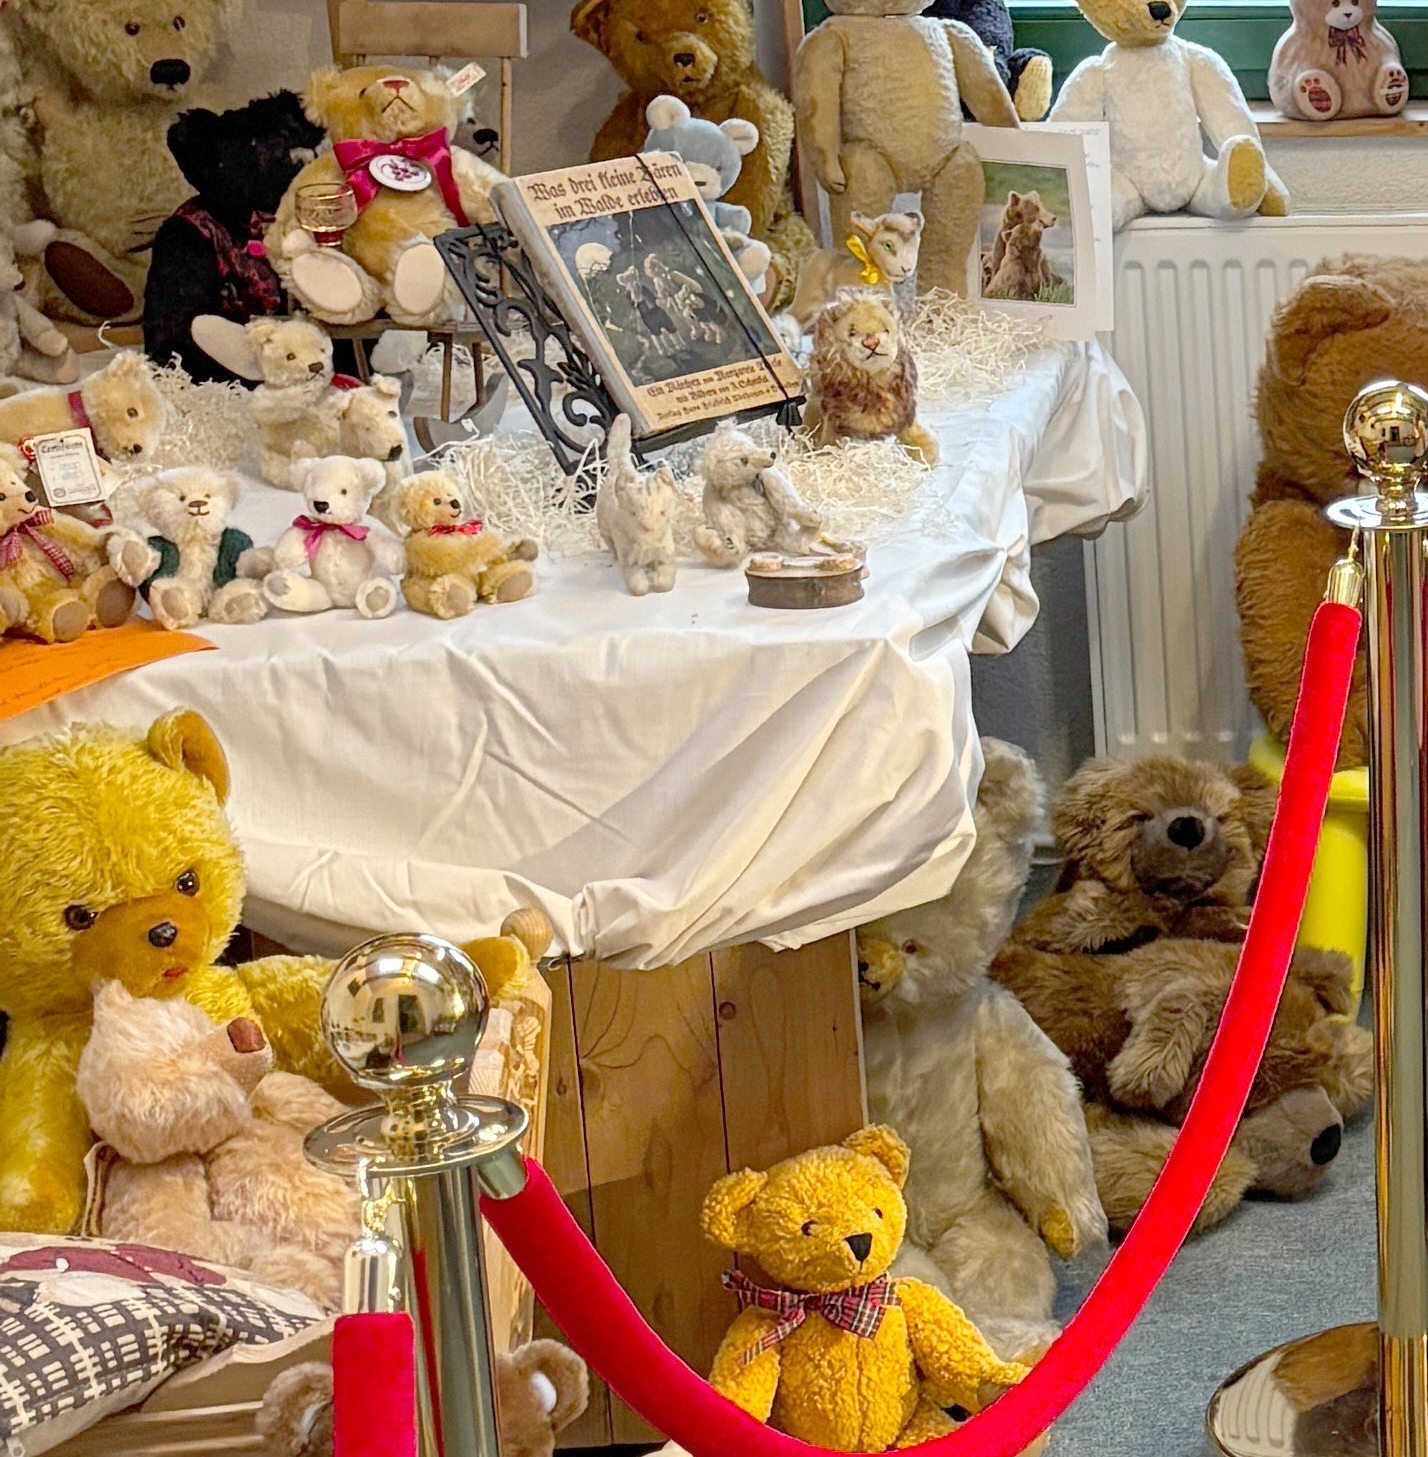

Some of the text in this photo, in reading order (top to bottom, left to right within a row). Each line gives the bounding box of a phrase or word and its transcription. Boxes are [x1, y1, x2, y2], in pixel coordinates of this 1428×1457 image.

[527, 183, 567, 202] Was
[568, 174, 597, 193] drei
[598, 168, 636, 190] kleine
[554, 202, 576, 220] im
[575, 195, 625, 216] Walde
